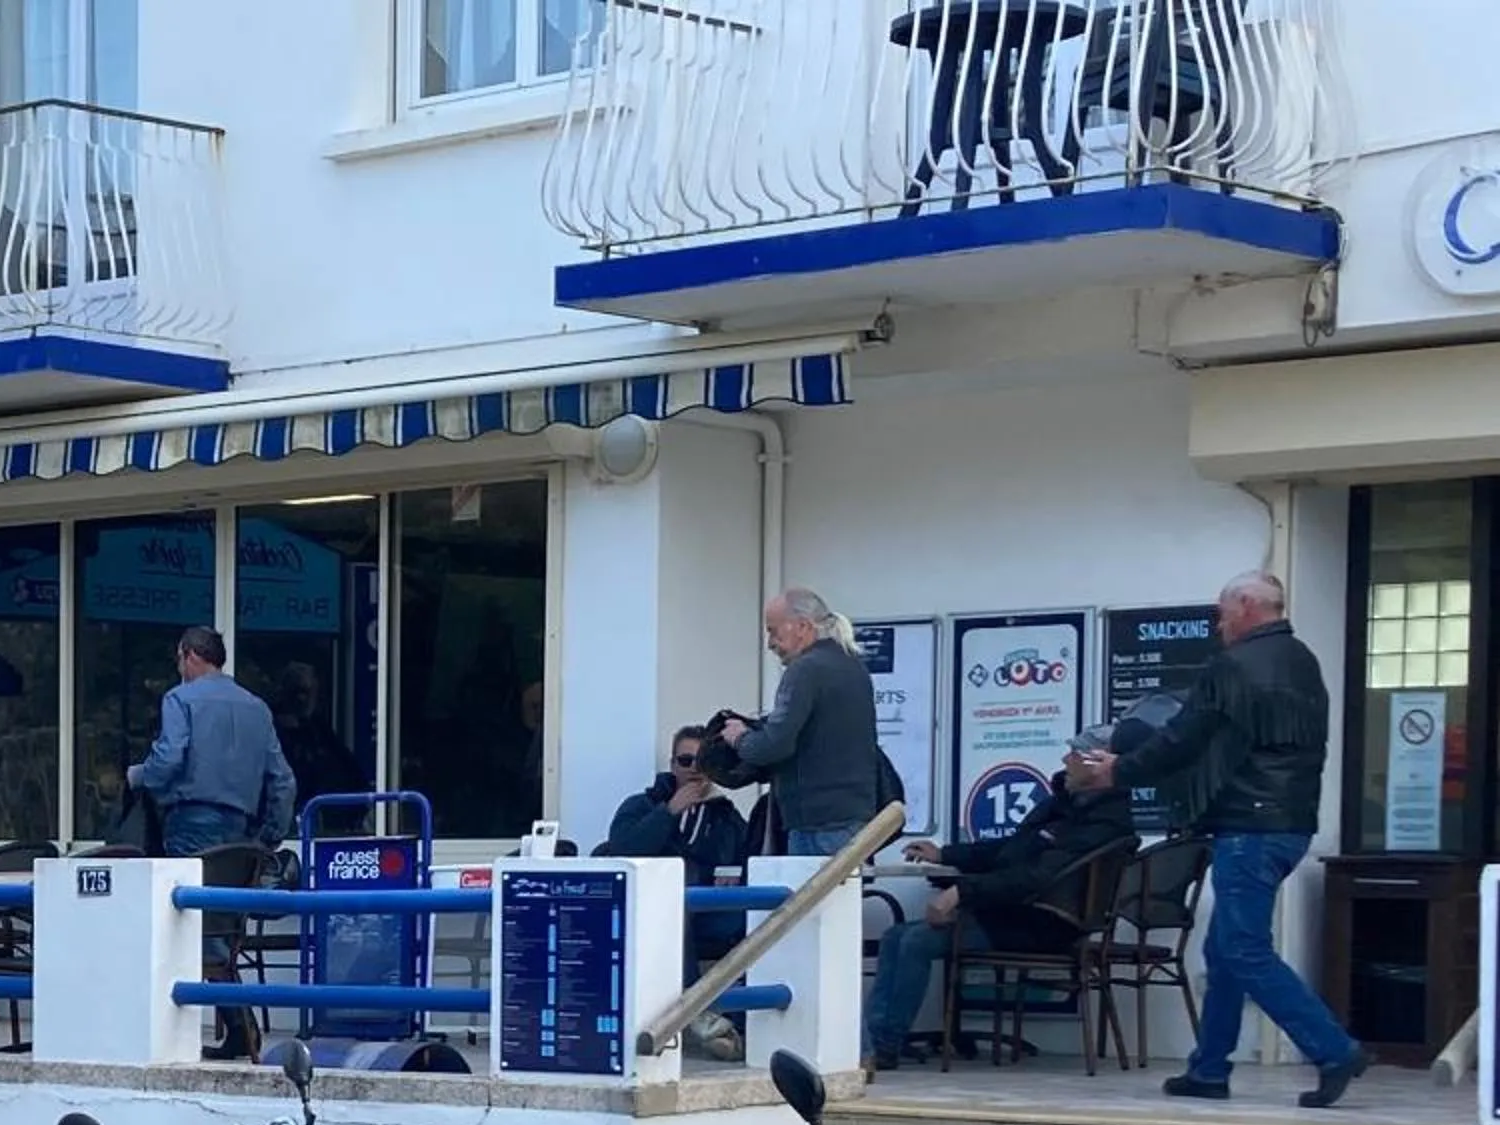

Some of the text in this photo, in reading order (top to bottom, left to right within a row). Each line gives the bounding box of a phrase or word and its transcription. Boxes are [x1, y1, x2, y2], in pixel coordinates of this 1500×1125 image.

[1138, 619, 1209, 640] SNACKING
[994, 660, 1068, 687] LOTO
[986, 781, 1038, 824] 13
[334, 847, 381, 865] ouest
[328, 861, 381, 880] france
[82, 871, 108, 891] 175
